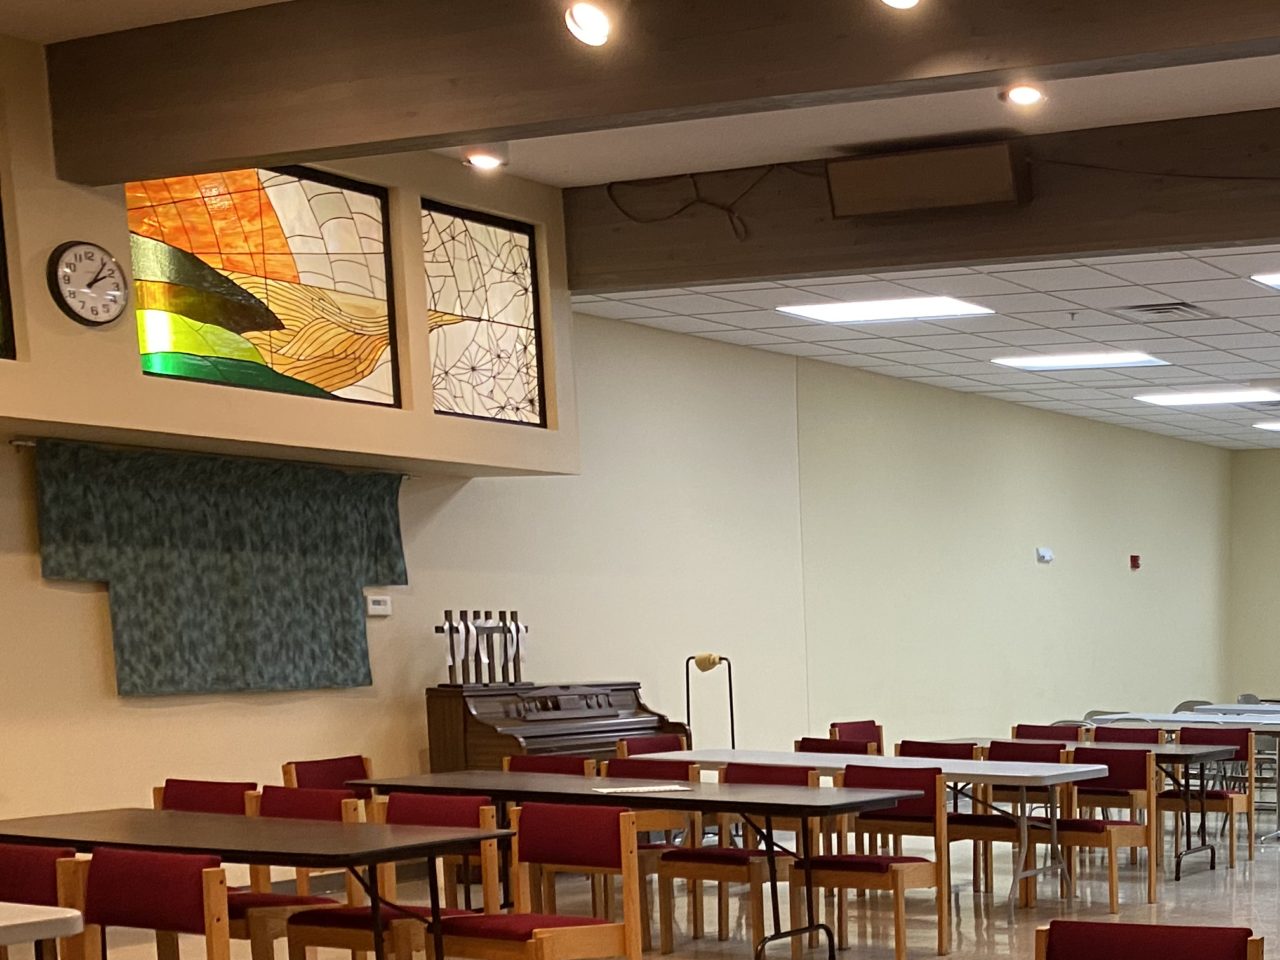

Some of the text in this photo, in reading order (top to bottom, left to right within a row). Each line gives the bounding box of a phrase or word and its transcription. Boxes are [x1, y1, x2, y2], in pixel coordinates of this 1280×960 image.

[63, 274, 71, 285] 9
[78, 300, 86, 310] 7
[102, 304, 110, 314] 5
[90, 306, 99, 316] 6
